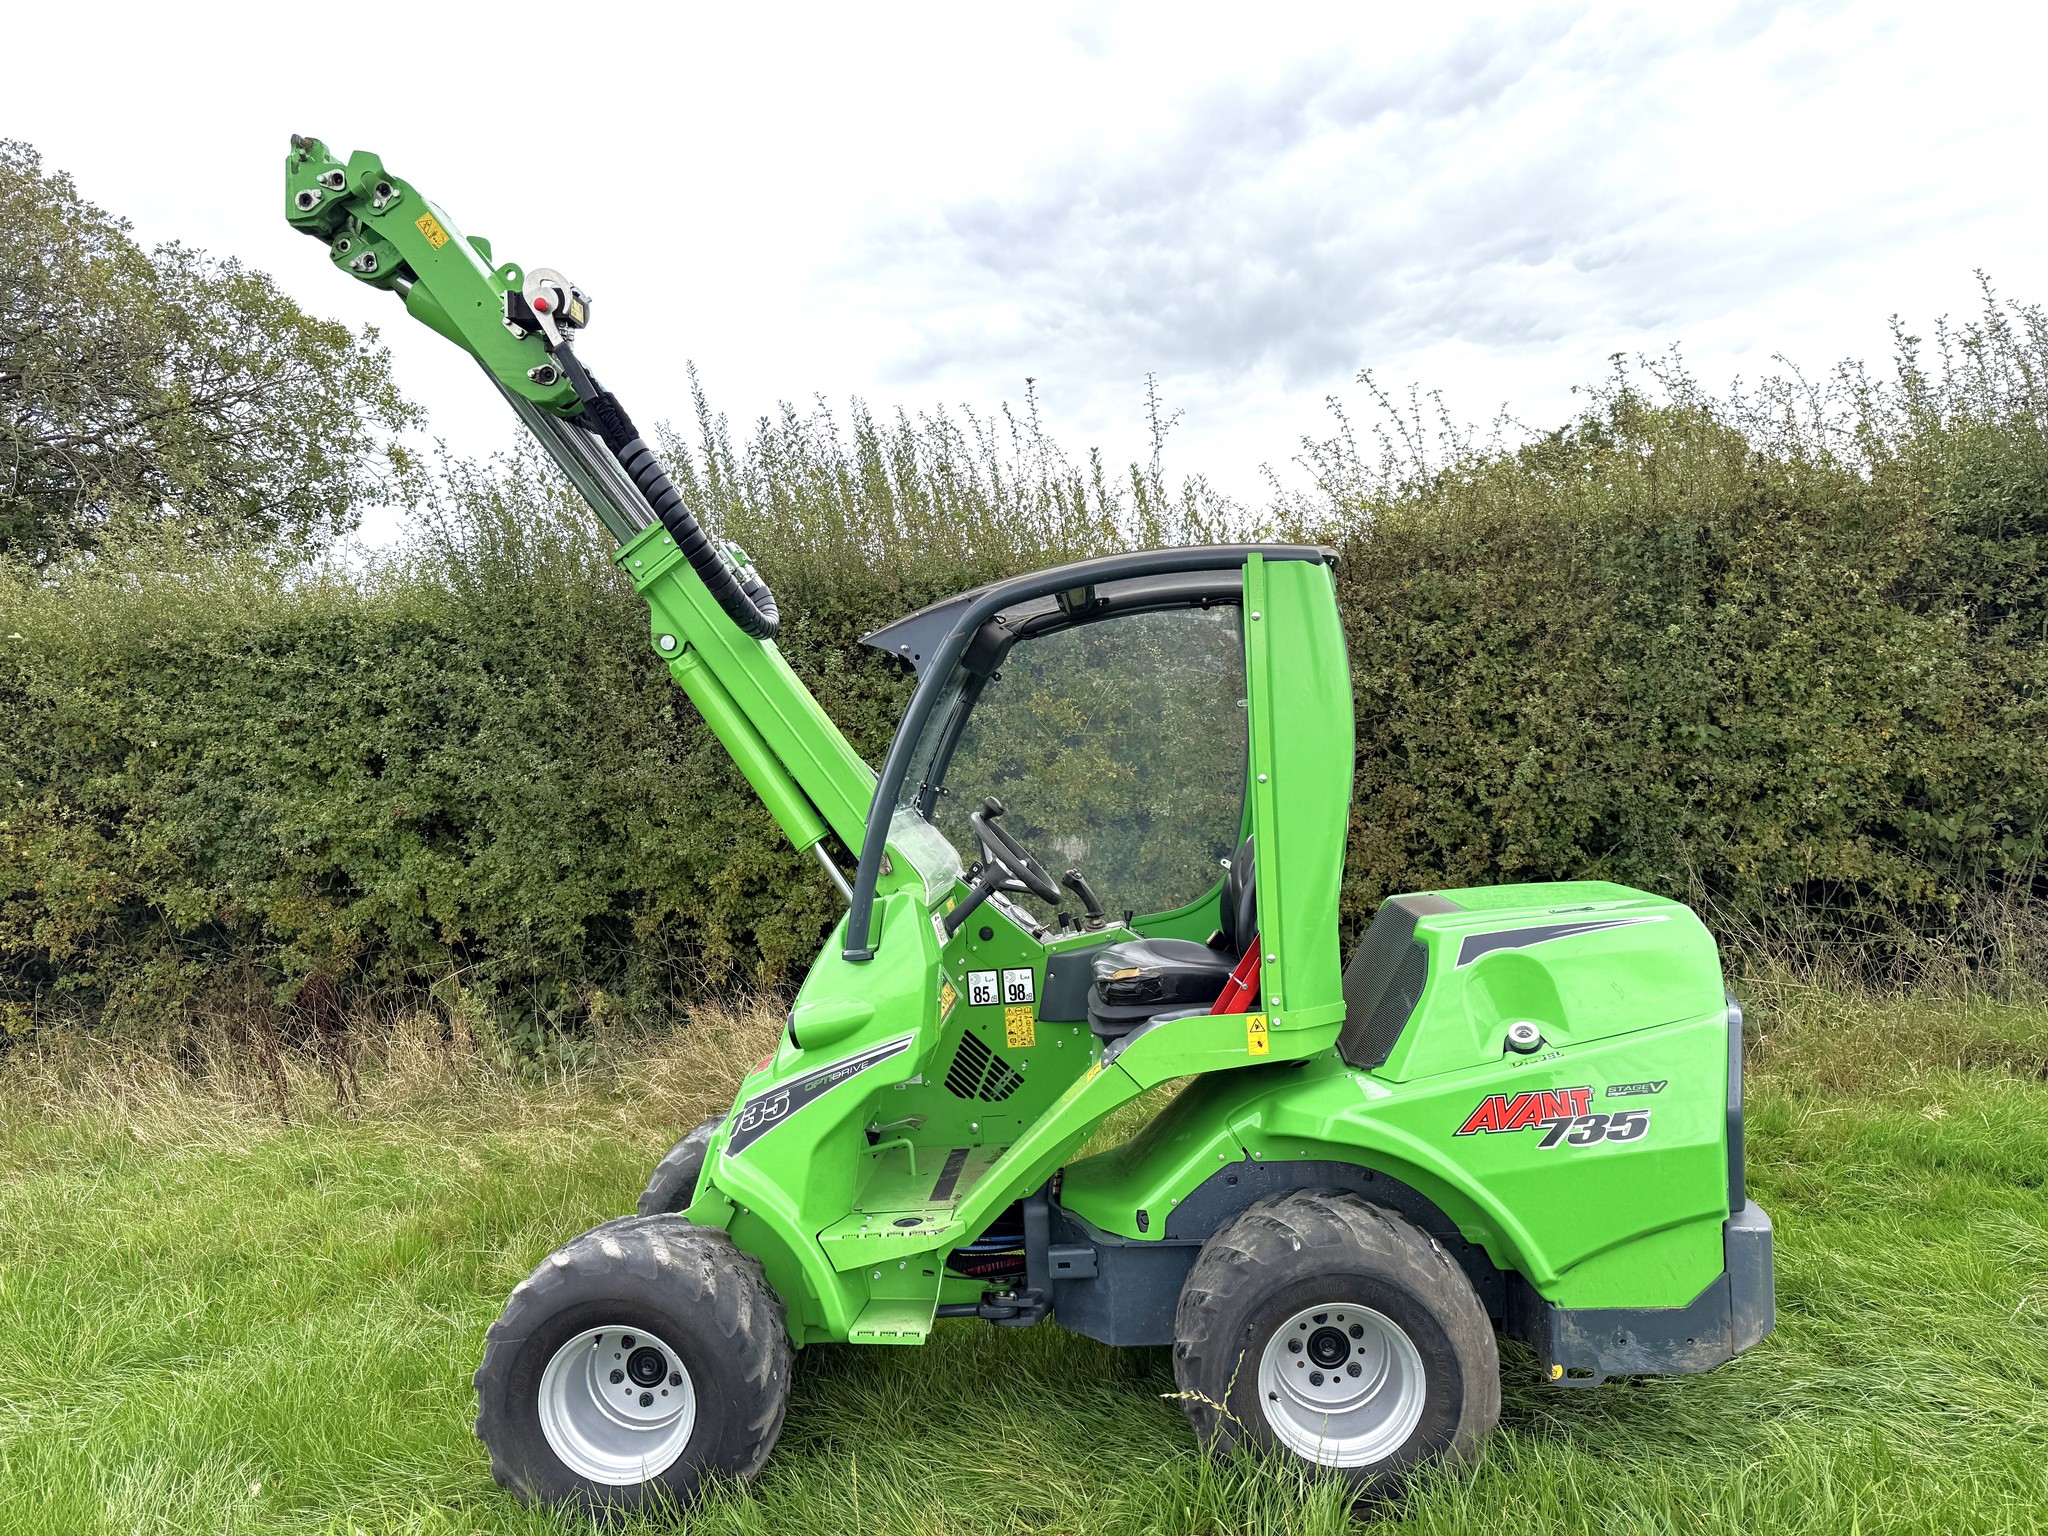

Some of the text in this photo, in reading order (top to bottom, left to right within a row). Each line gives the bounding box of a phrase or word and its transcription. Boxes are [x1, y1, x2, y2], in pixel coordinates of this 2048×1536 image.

[974, 986, 990, 1003] 85
[1008, 983, 1026, 1001] 98
[804, 1060, 869, 1092] OPTIDRIVE
[1608, 1084, 1649, 1092] STAGE
[1650, 1082, 1666, 1092] V
[1454, 1087, 1593, 1135] AVANT
[1537, 1110, 1651, 1149] 735
